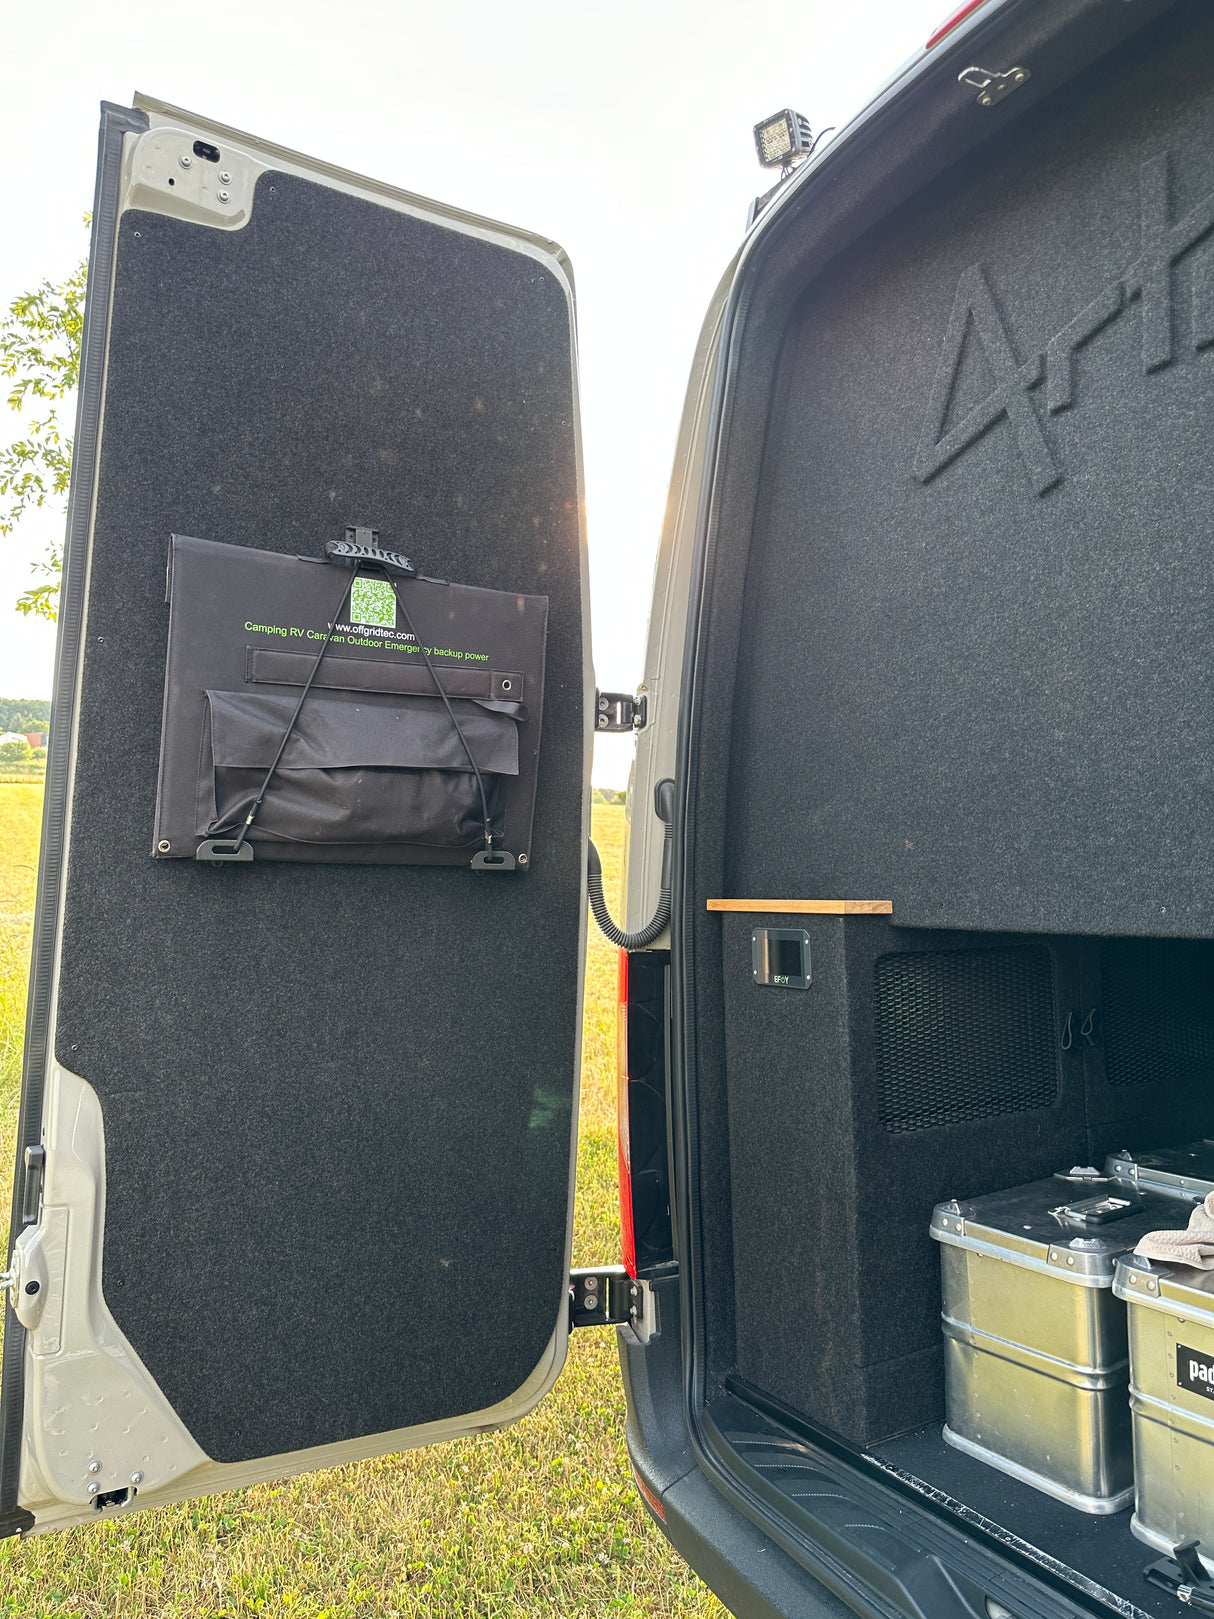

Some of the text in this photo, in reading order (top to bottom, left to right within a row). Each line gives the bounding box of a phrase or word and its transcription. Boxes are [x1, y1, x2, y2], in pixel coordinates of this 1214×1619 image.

[244, 621, 288, 637] Camping
[290, 627, 305, 638] RV
[307, 630, 345, 643] Caravan
[347, 635, 383, 648] Outdoor
[433, 646, 464, 659] backup
[465, 652, 489, 661] power
[774, 975, 789, 984] EFOY
